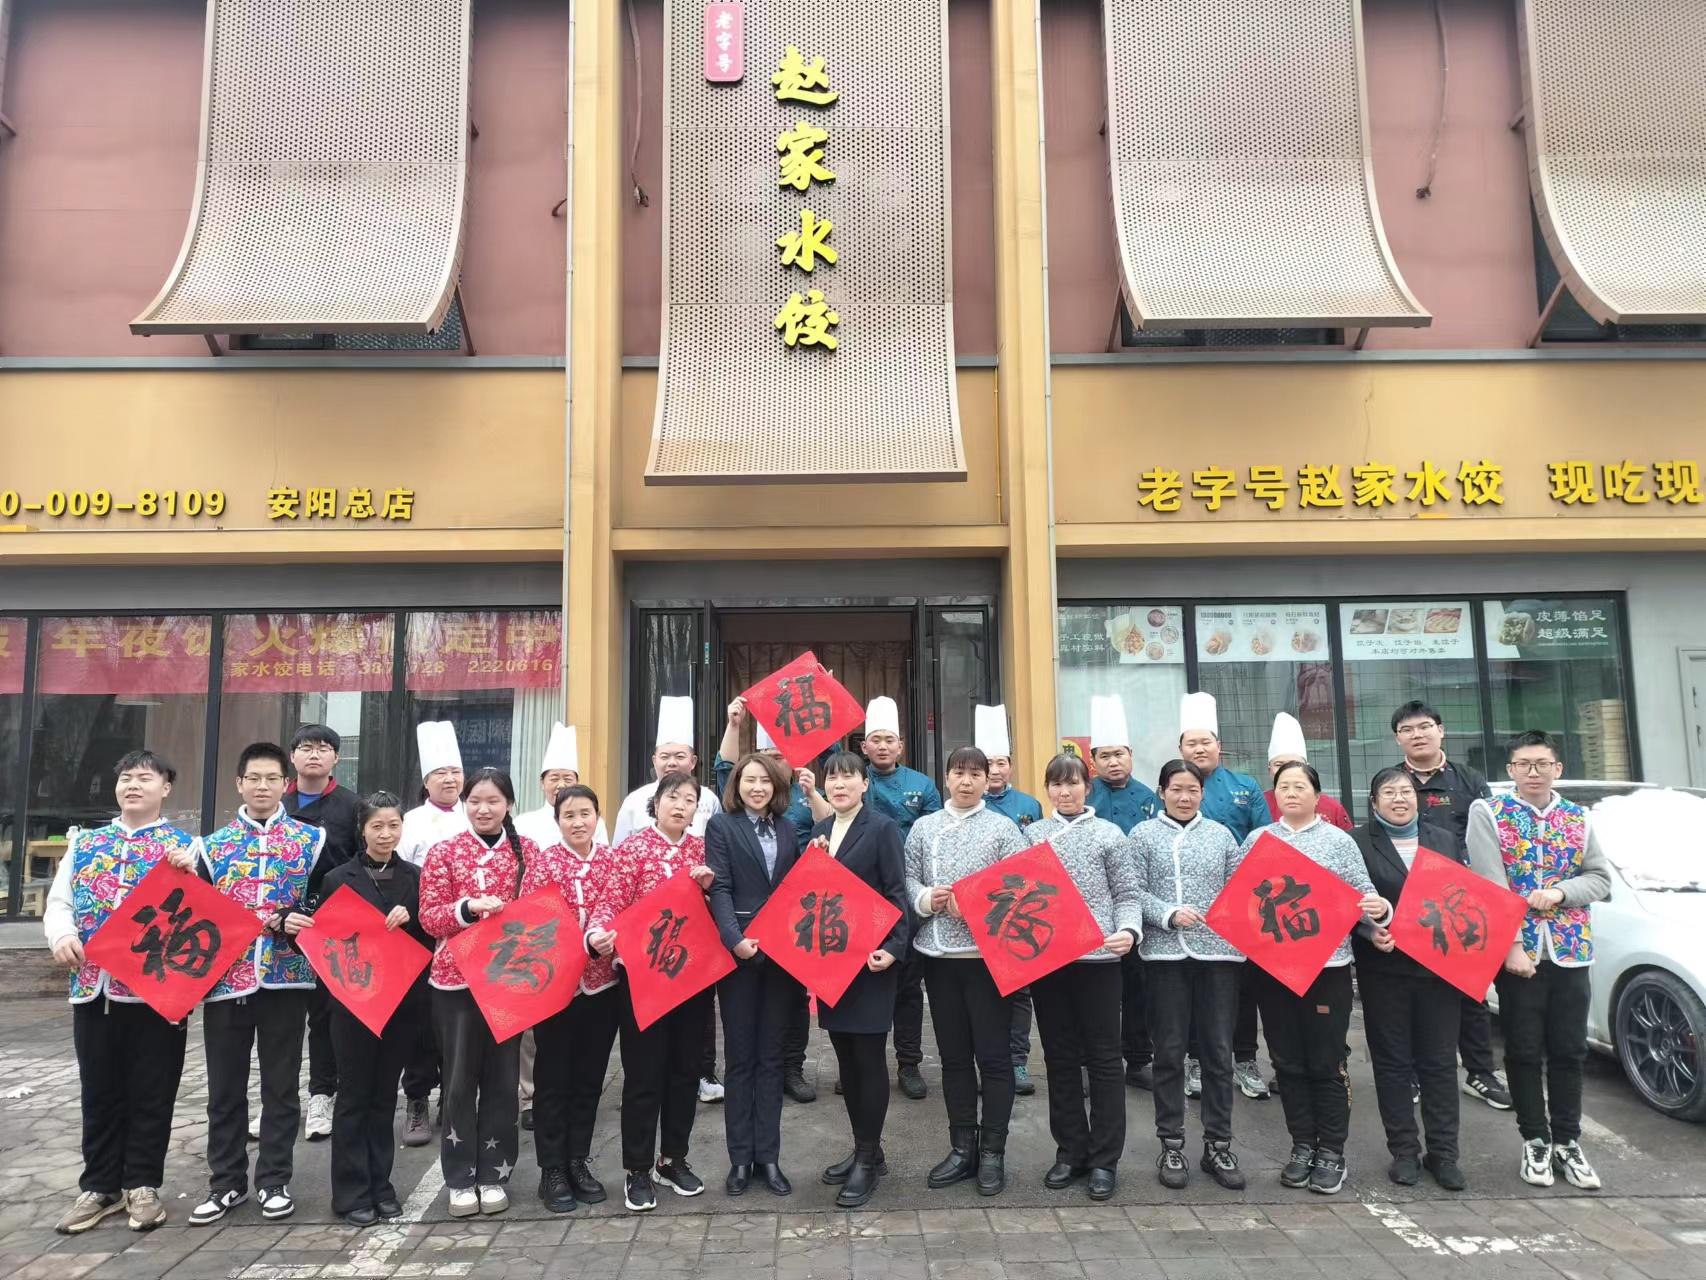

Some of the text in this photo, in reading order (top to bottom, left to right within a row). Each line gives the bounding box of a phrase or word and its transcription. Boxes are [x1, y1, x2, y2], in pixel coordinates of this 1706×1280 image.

[714, 10, 735, 73] 老字号
[771, 42, 840, 352] 赵家水饺
[266, 486, 415, 520] 安阳总店
[1138, 458, 1706, 512] 老字号赵家水饺 现吃现
[1536, 609, 1607, 623] 皮薄馅足
[1537, 626, 1608, 640] 超级满足
[773, 672, 833, 738] 福
[130, 887, 221, 982] 福
[795, 890, 849, 957] 福
[985, 873, 1060, 961] 福
[1252, 873, 1321, 943] 福
[1418, 882, 1488, 956] 福
[323, 931, 375, 989] 福
[482, 917, 559, 996] 福
[646, 908, 689, 980] 福
